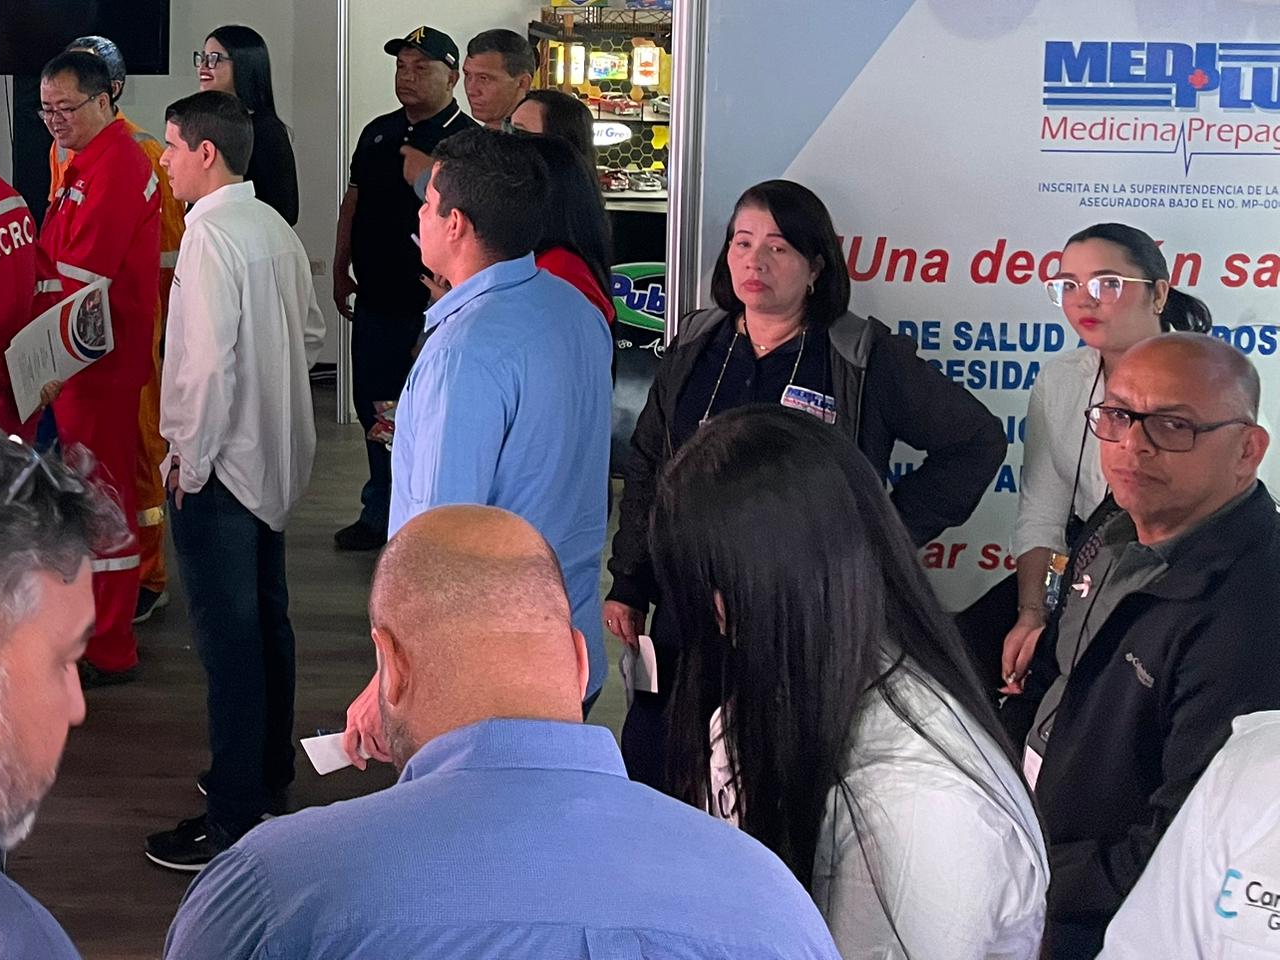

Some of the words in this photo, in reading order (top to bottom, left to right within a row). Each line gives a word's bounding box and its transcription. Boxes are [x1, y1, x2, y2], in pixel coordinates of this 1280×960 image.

[1040, 116, 1177, 141] Medicina
[1038, 182, 1091, 194] INSCRITA
[1094, 183, 1109, 194] EN
[1112, 183, 1127, 194] LA
[1130, 184, 1244, 195] SUPERINTENDENCIA
[1247, 185, 1262, 195] DE
[1265, 185, 1279, 195] LA
[1079, 197, 1166, 208] ASEGURADORA
[1168, 198, 1199, 208] BAJO
[1201, 199, 1215, 208] EL
[1217, 199, 1238, 209] NO.
[1241, 199, 1280, 209] MP-00
[952, 321, 1065, 353] SALUD
[922, 542, 968, 569] ar
